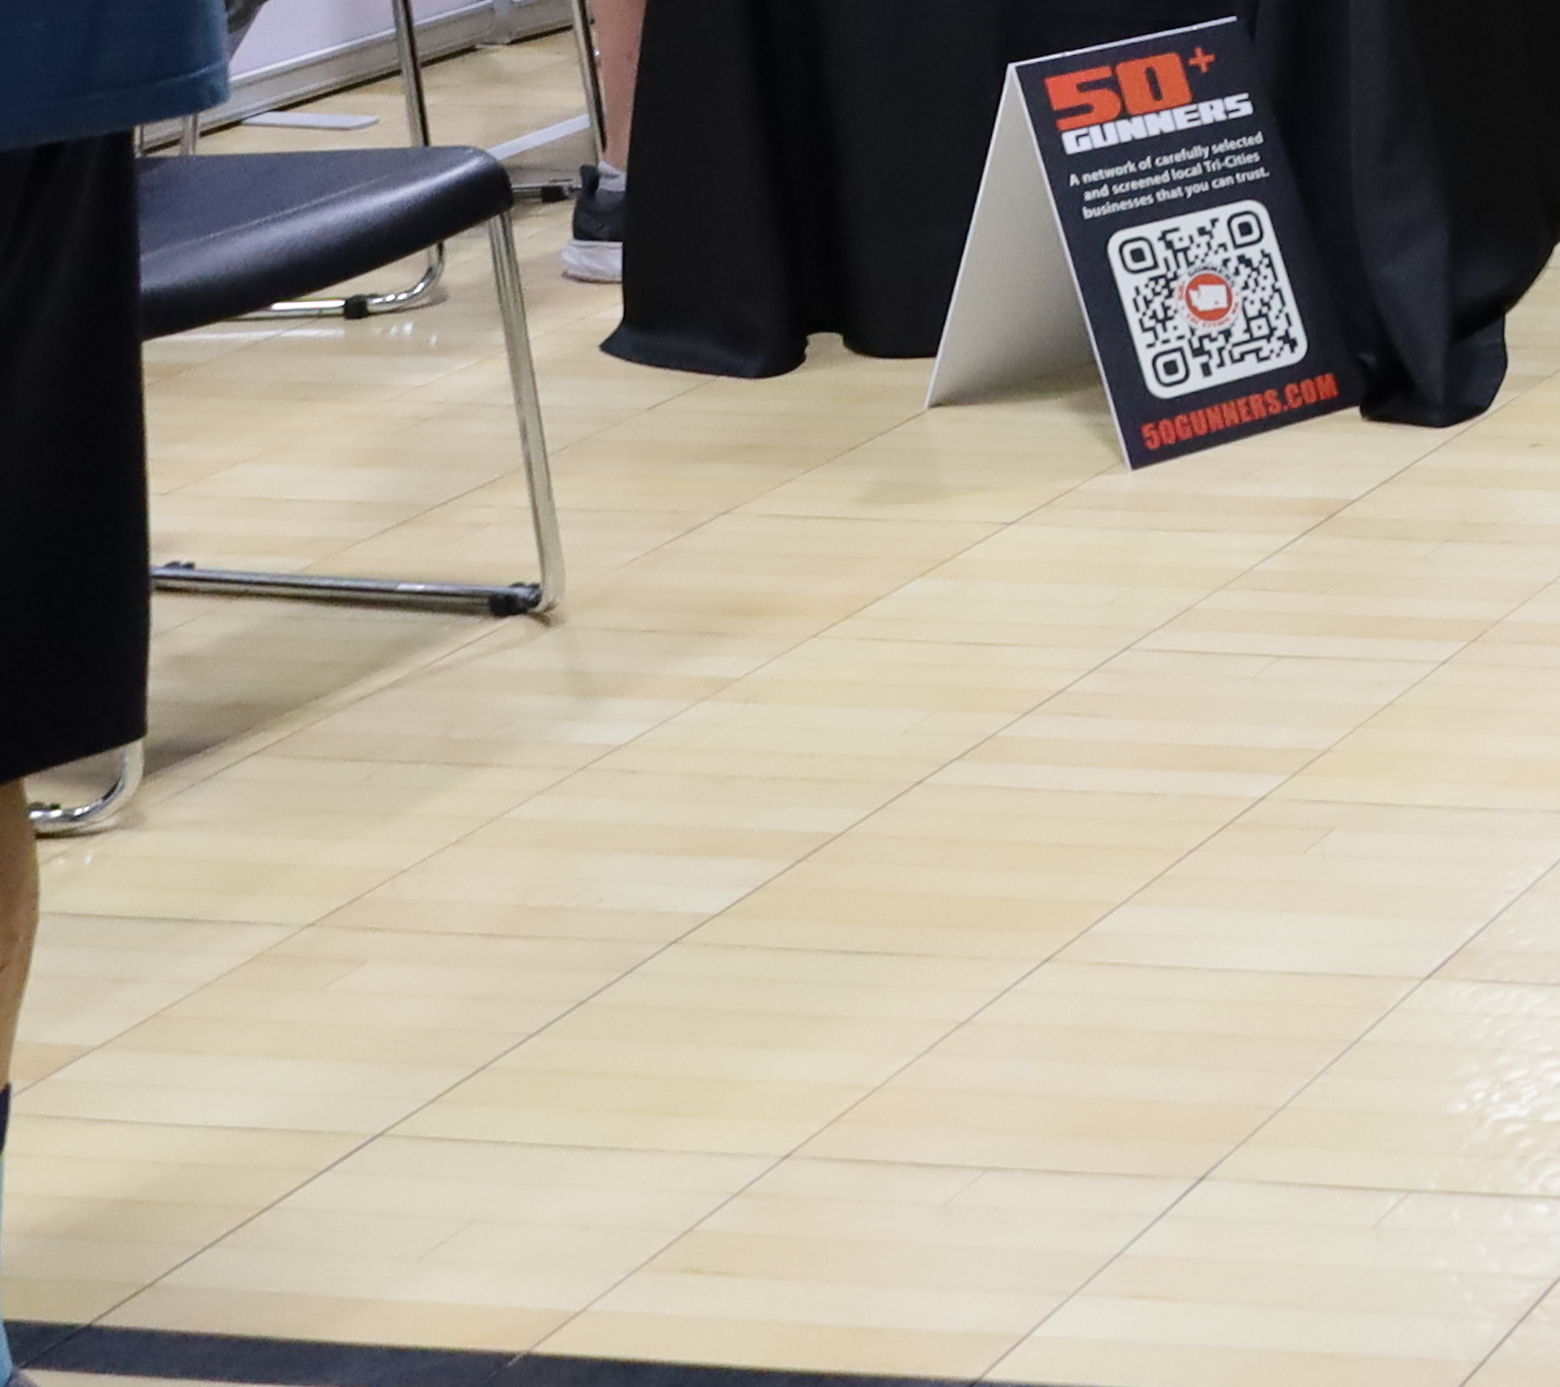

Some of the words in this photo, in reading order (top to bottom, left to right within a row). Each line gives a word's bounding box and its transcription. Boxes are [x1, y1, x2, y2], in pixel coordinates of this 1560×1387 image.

[1044, 46, 1217, 131] 50+
[1061, 92, 1254, 155] GUNNERS
[1068, 173, 1081, 187] A
[1082, 160, 1137, 184] network
[1138, 155, 1154, 170] of
[1155, 143, 1209, 168] carefully
[1211, 130, 1264, 154] selected
[1083, 184, 1109, 202] and
[1111, 173, 1170, 195] screened
[1171, 163, 1203, 180] local
[1203, 150, 1261, 173] Tri-Cities
[1082, 190, 1154, 220] businesses
[1155, 186, 1184, 203] that
[1184, 178, 1209, 199] you
[1211, 175, 1235, 189] can
[1235, 165, 1270, 184] trust.
[1140, 372, 1339, 450] 50GUNNERS.COM
